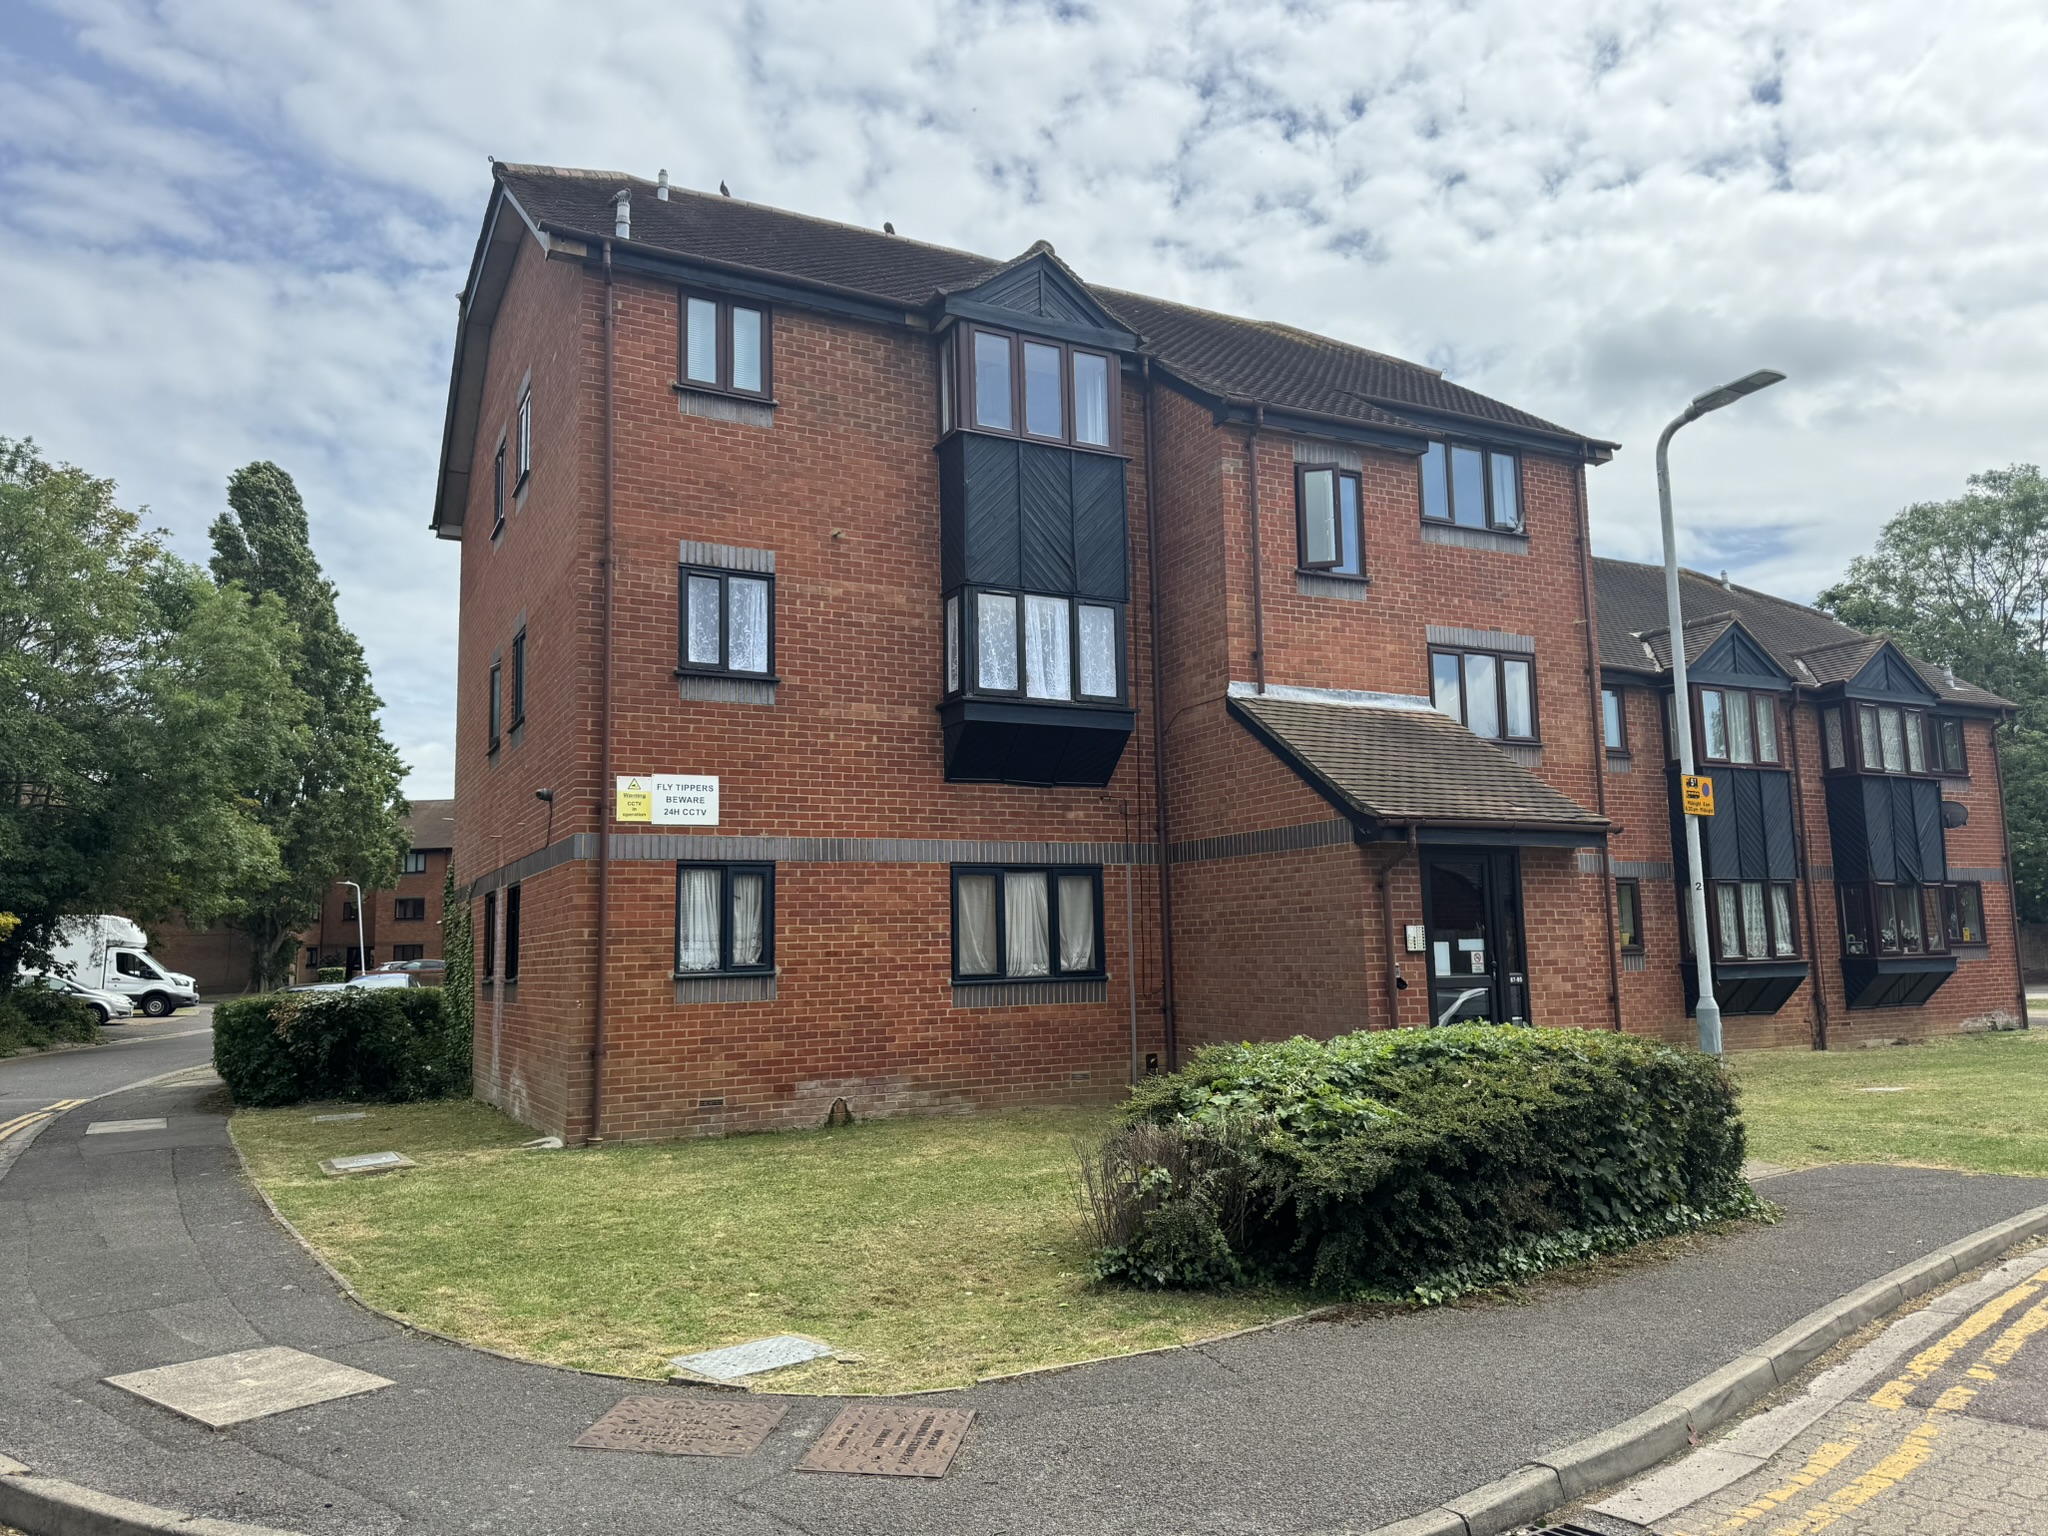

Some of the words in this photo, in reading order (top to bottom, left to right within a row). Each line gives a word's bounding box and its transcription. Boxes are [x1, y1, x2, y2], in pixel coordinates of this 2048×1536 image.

[657, 783, 673, 791] FLY
[676, 783, 714, 792] TIPPERS
[665, 795, 705, 804] BEWARE
[663, 808, 680, 816] 24H
[682, 808, 707, 816] CCTV
[1695, 881, 1702, 891] 2
